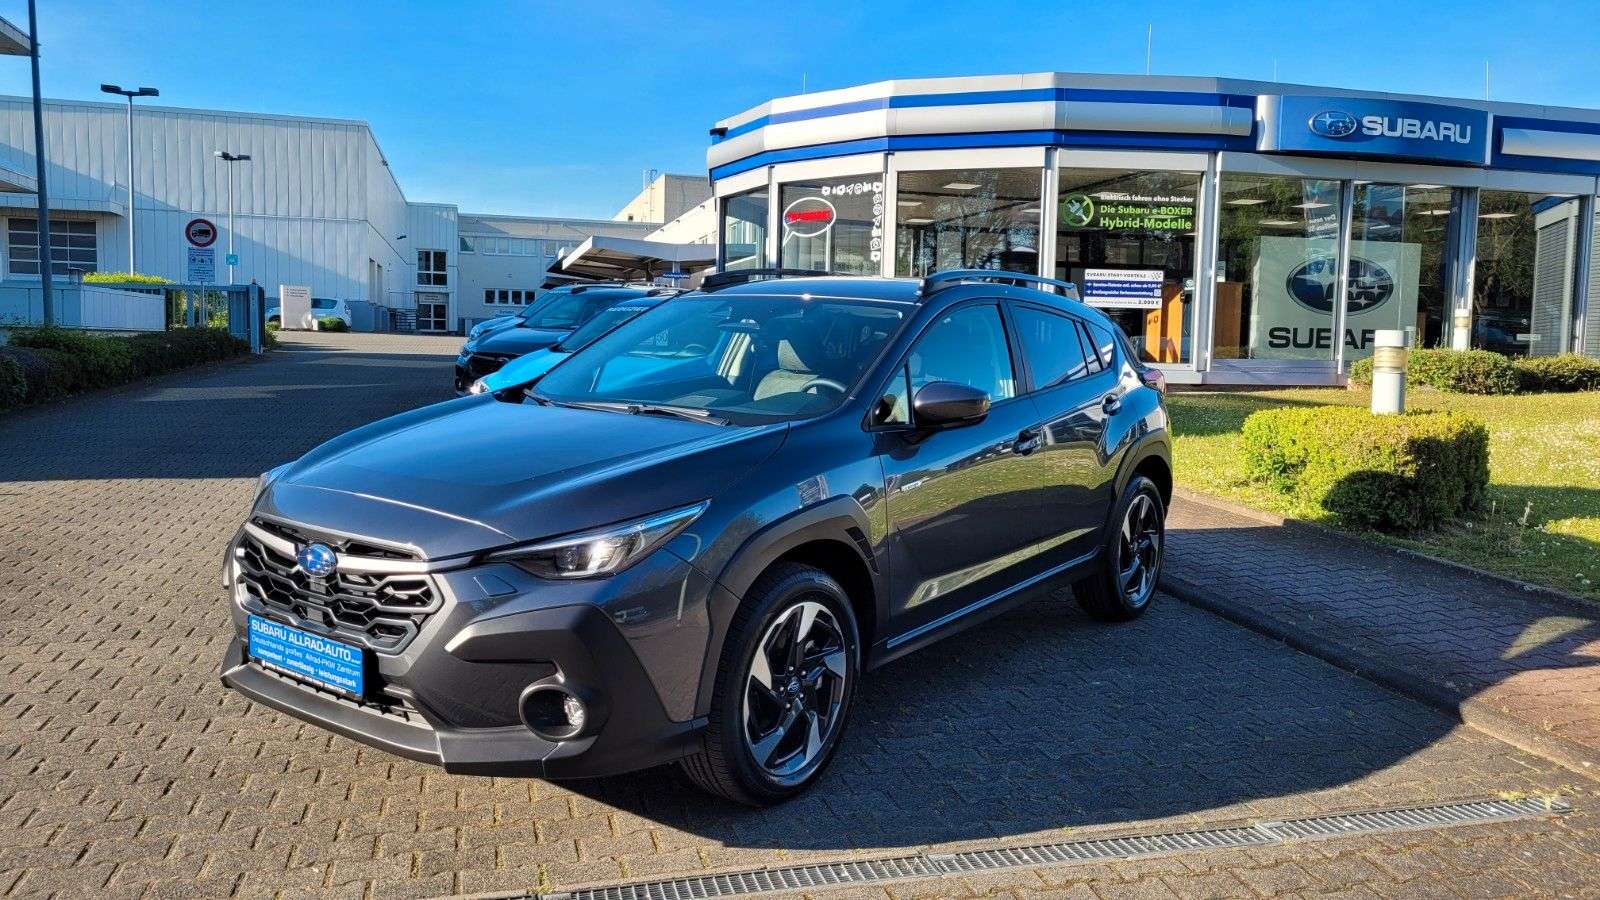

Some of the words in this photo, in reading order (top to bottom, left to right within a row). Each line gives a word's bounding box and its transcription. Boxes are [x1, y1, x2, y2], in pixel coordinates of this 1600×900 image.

[1362, 115, 1471, 144] SUBARU
[1170, 195, 1194, 203] Stecker
[1100, 205, 1115, 214] Die
[1118, 205, 1150, 214] Subaru
[1152, 206, 1193, 215] e-BOXER
[1100, 217, 1192, 230] Hybrid-Modelle
[1268, 326, 1375, 349] SUBAR
[251, 619, 287, 641] SUBARU
[288, 632, 352, 662] ALLRAD-AUTO
